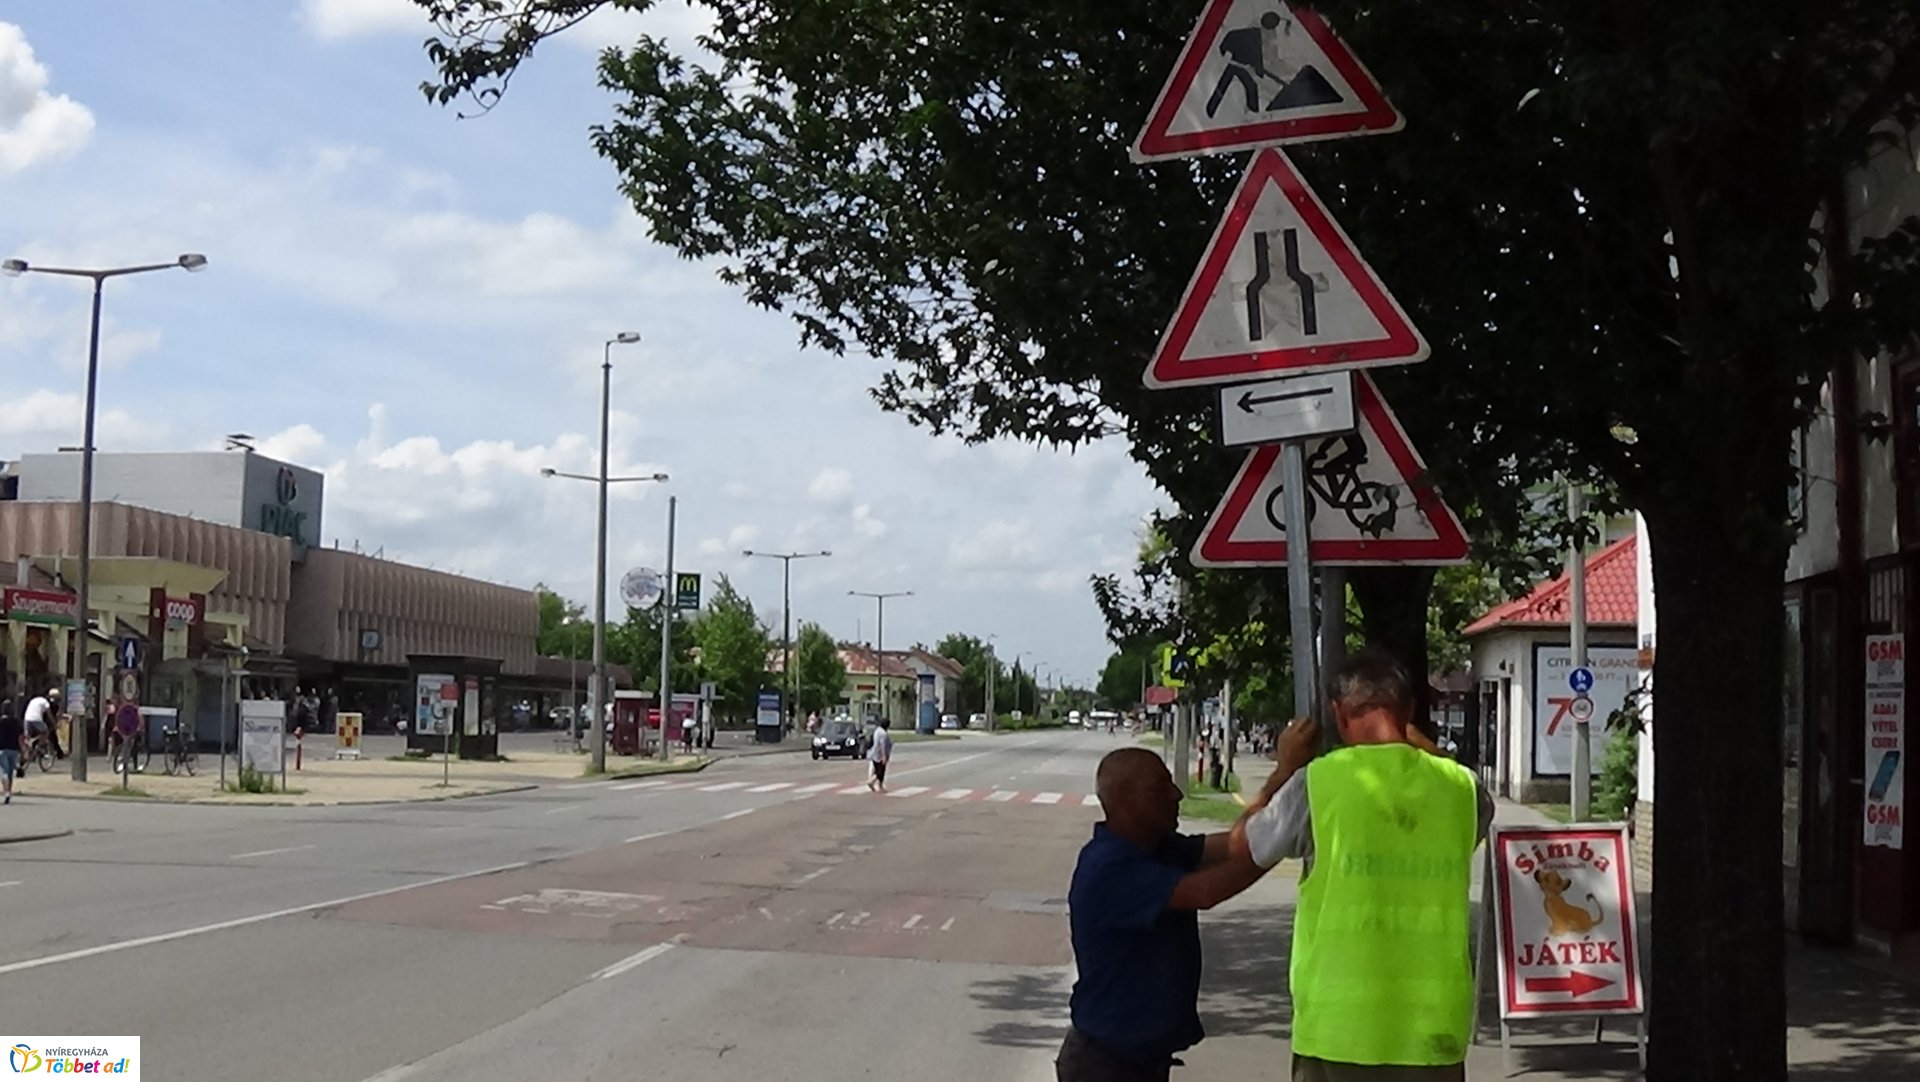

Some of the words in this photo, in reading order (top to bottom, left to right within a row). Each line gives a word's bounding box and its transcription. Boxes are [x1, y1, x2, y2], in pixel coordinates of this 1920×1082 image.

[1547, 657, 1596, 668] CITRN
[1869, 640, 1902, 662] GSM
[1867, 804, 1900, 827] GSM
[1515, 841, 1611, 875] Simba
[1518, 936, 1621, 967] JÁTÉK
